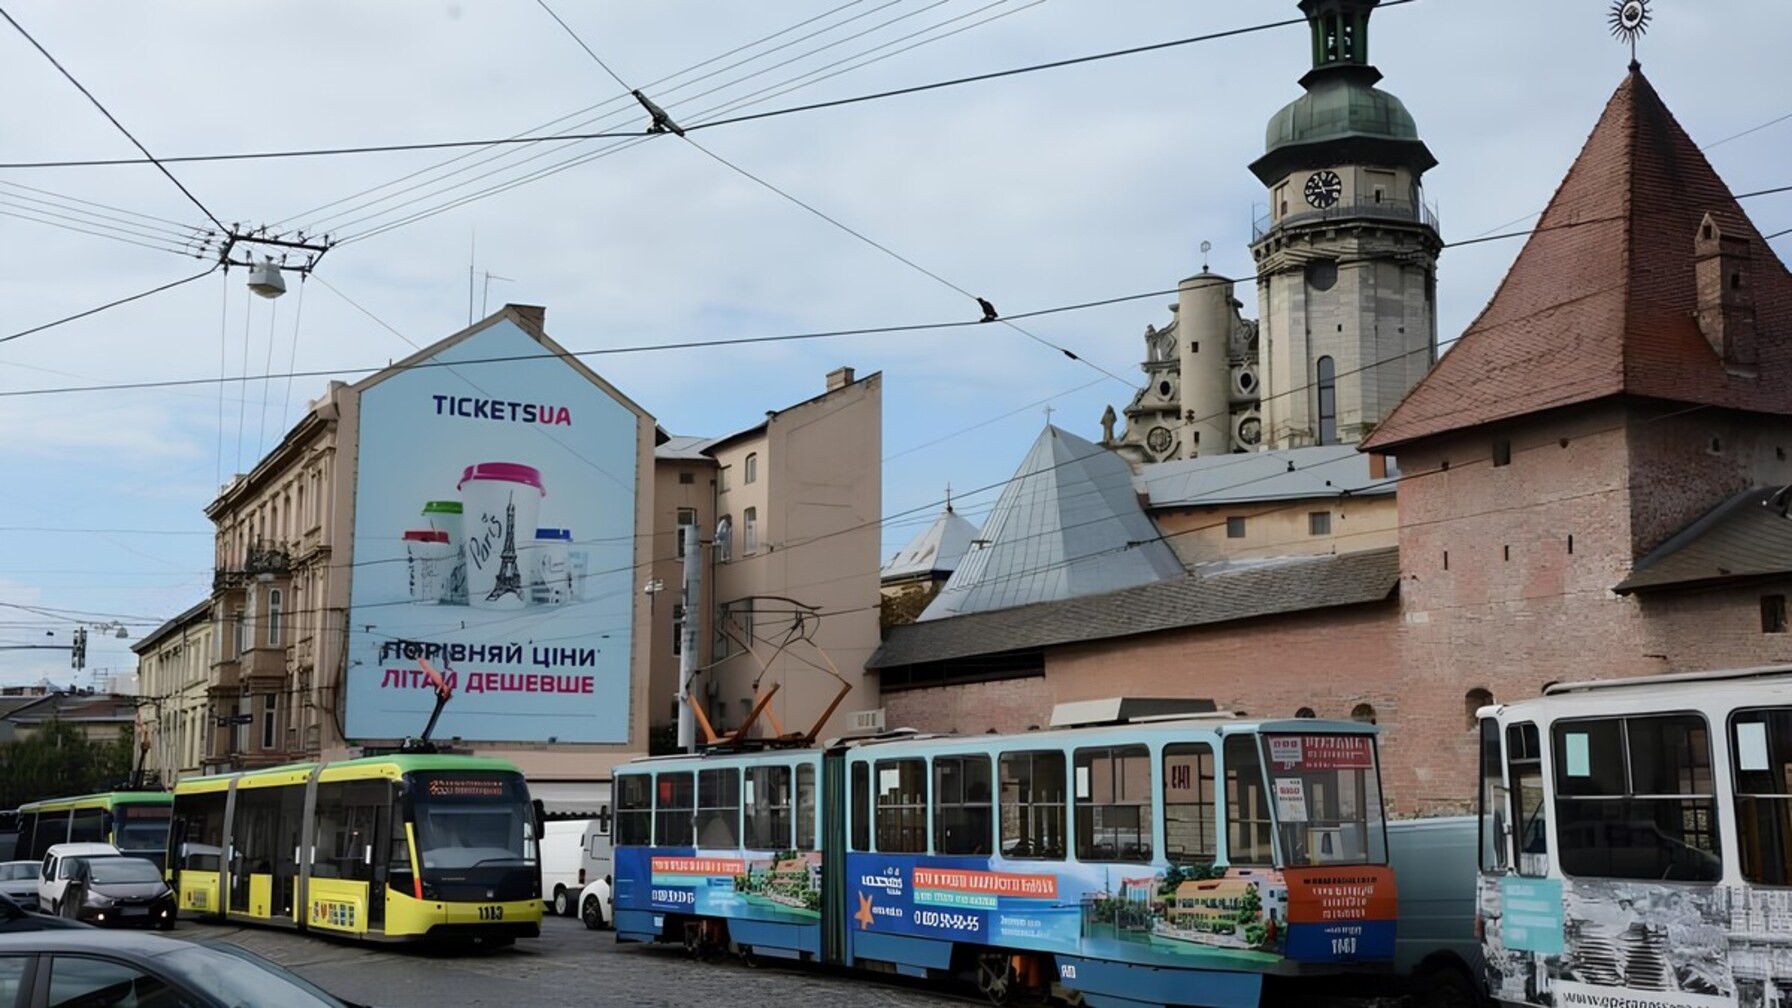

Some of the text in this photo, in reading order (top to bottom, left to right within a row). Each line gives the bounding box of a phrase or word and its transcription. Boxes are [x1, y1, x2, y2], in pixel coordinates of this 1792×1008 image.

[381, 640, 596, 668] ПОРІВНЯЙ ЦІНИ
[465, 672, 595, 694] ДЕШЕВШЕ
